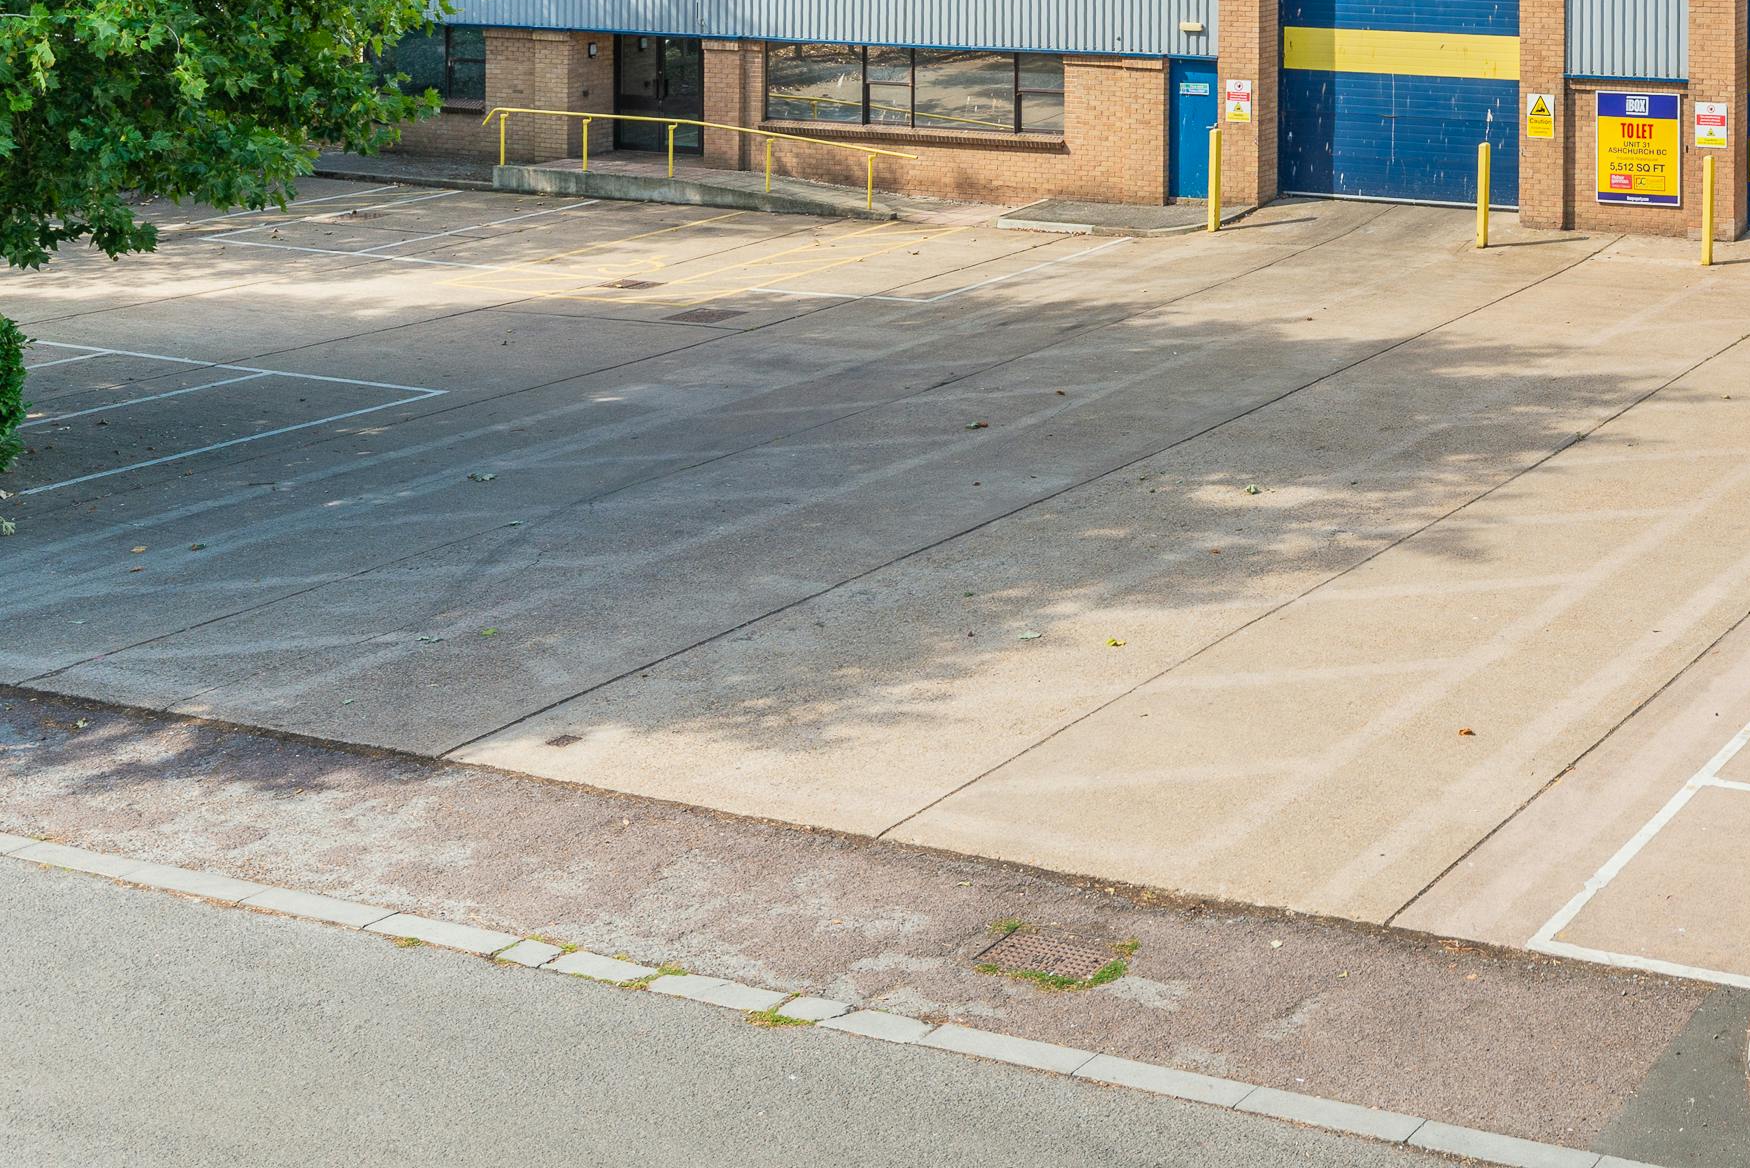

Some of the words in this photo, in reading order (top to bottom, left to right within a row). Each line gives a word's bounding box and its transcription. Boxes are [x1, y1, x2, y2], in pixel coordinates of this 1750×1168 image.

[1620, 122, 1634, 139] TO
[1636, 123, 1654, 139] LET
[1608, 147, 1654, 155] ASHCHURCH
[1609, 162, 1634, 171] 5,512
[1636, 163, 1650, 172] SQ
[1653, 164, 1665, 173] FT
